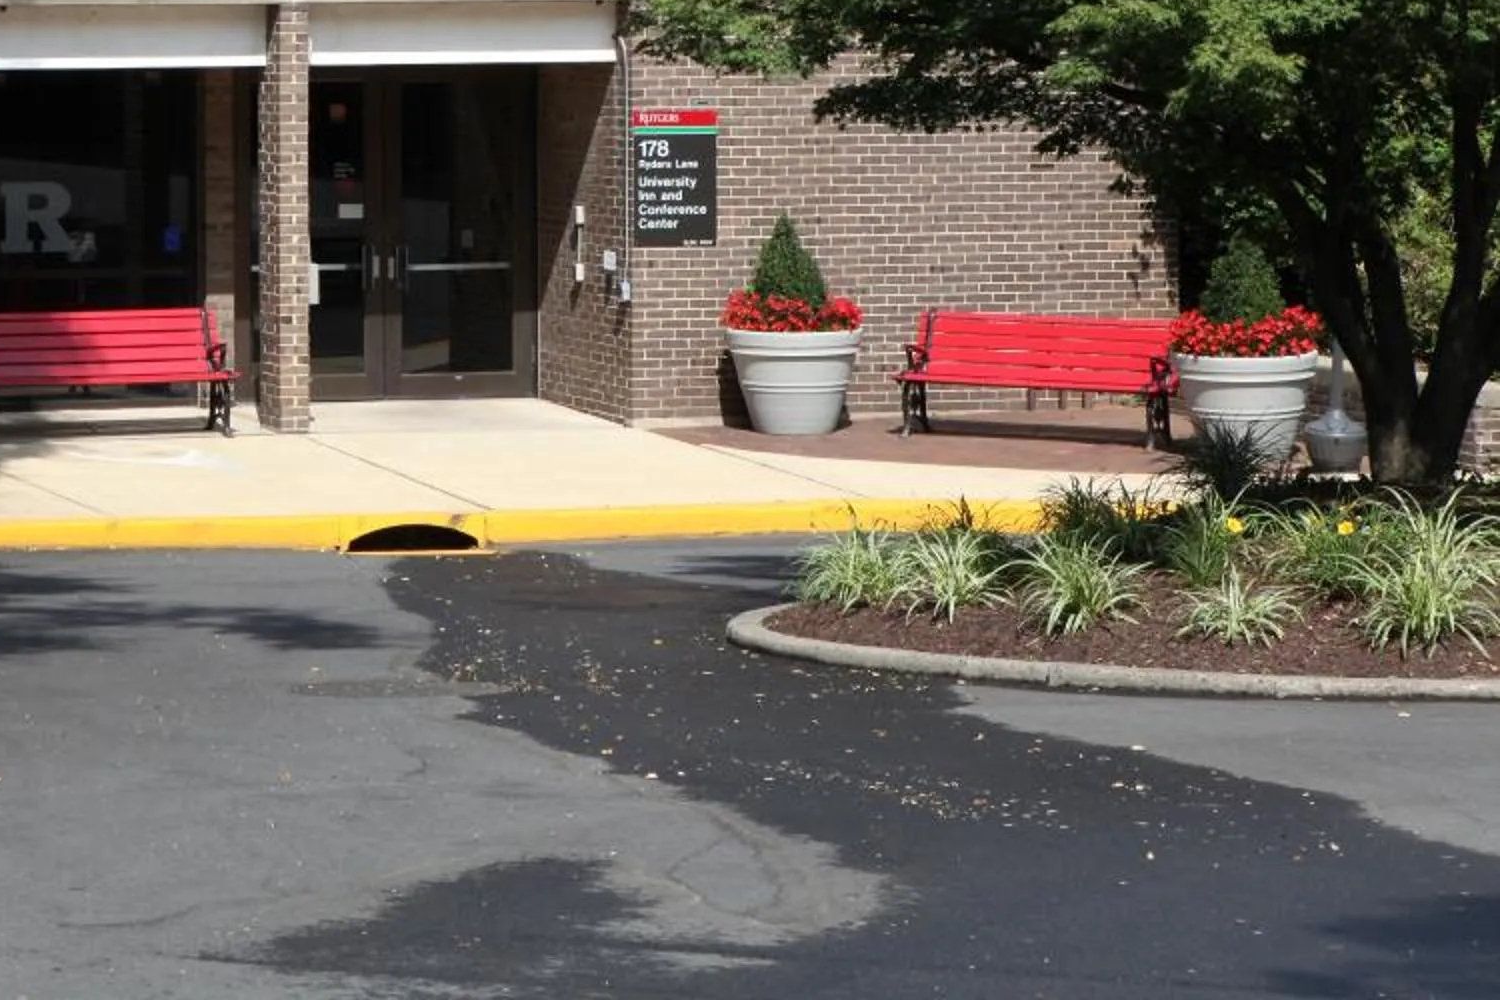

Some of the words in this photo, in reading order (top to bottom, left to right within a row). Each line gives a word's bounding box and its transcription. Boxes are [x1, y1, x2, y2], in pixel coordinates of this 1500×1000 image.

[638, 139, 669, 157] 178
[675, 160, 699, 168] Lane
[638, 176, 697, 189] University
[638, 190, 657, 201] Inn
[661, 190, 683, 201] and
[638, 204, 707, 215] Conference
[0, 181, 75, 254] R
[638, 219, 679, 229] Center
